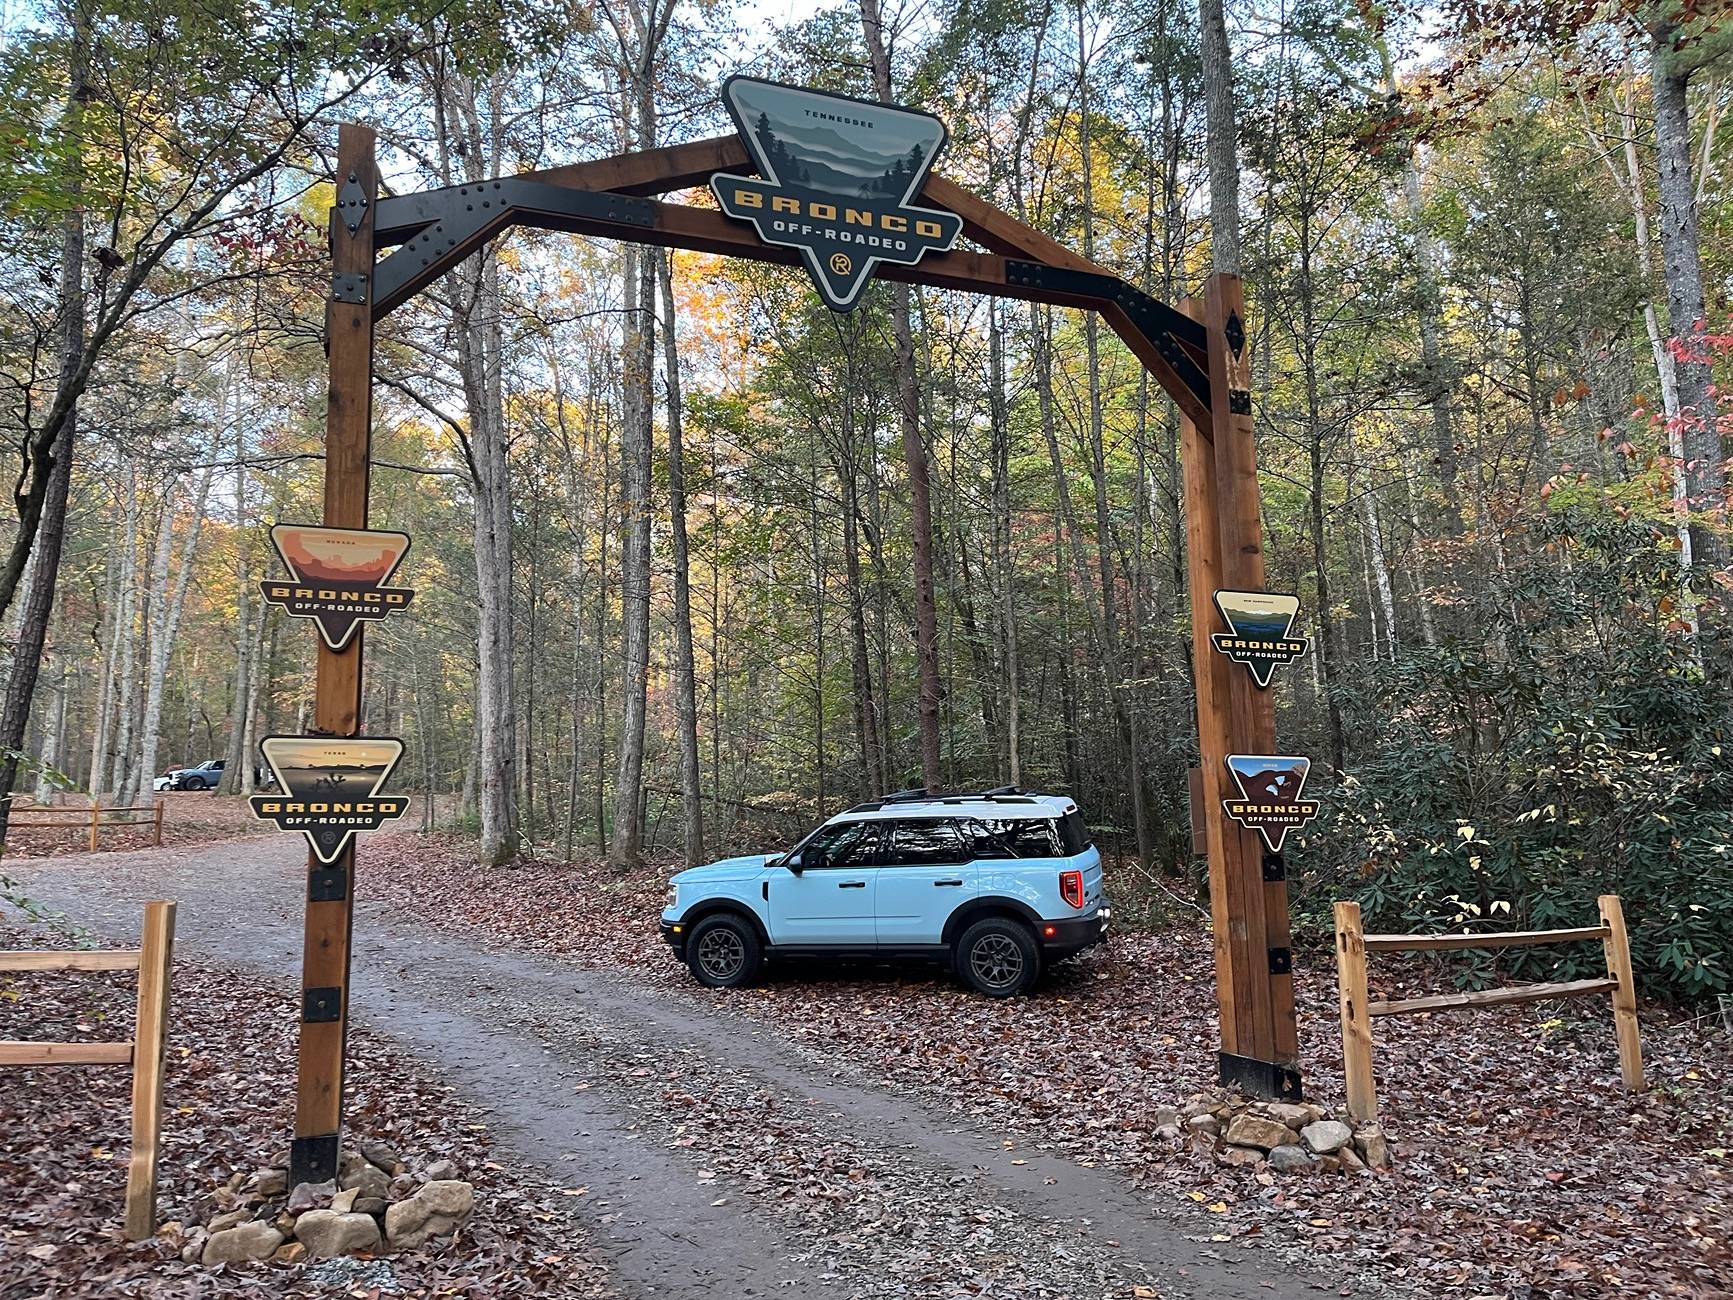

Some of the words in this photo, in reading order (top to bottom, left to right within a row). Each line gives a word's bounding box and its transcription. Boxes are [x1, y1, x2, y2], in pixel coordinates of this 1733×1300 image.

[804, 109, 874, 129] TENNESSEE
[734, 189, 942, 239] BRONCO
[773, 220, 907, 251] OFF-ROADEO
[271, 587, 404, 604] BRONCO
[295, 603, 380, 613] OFF-ROADEO
[1221, 639, 1301, 651] BRONCO
[1236, 651, 1288, 659] OFF-ROADEO
[262, 803, 397, 813] BRONCO
[1232, 805, 1313, 813] BRONCO
